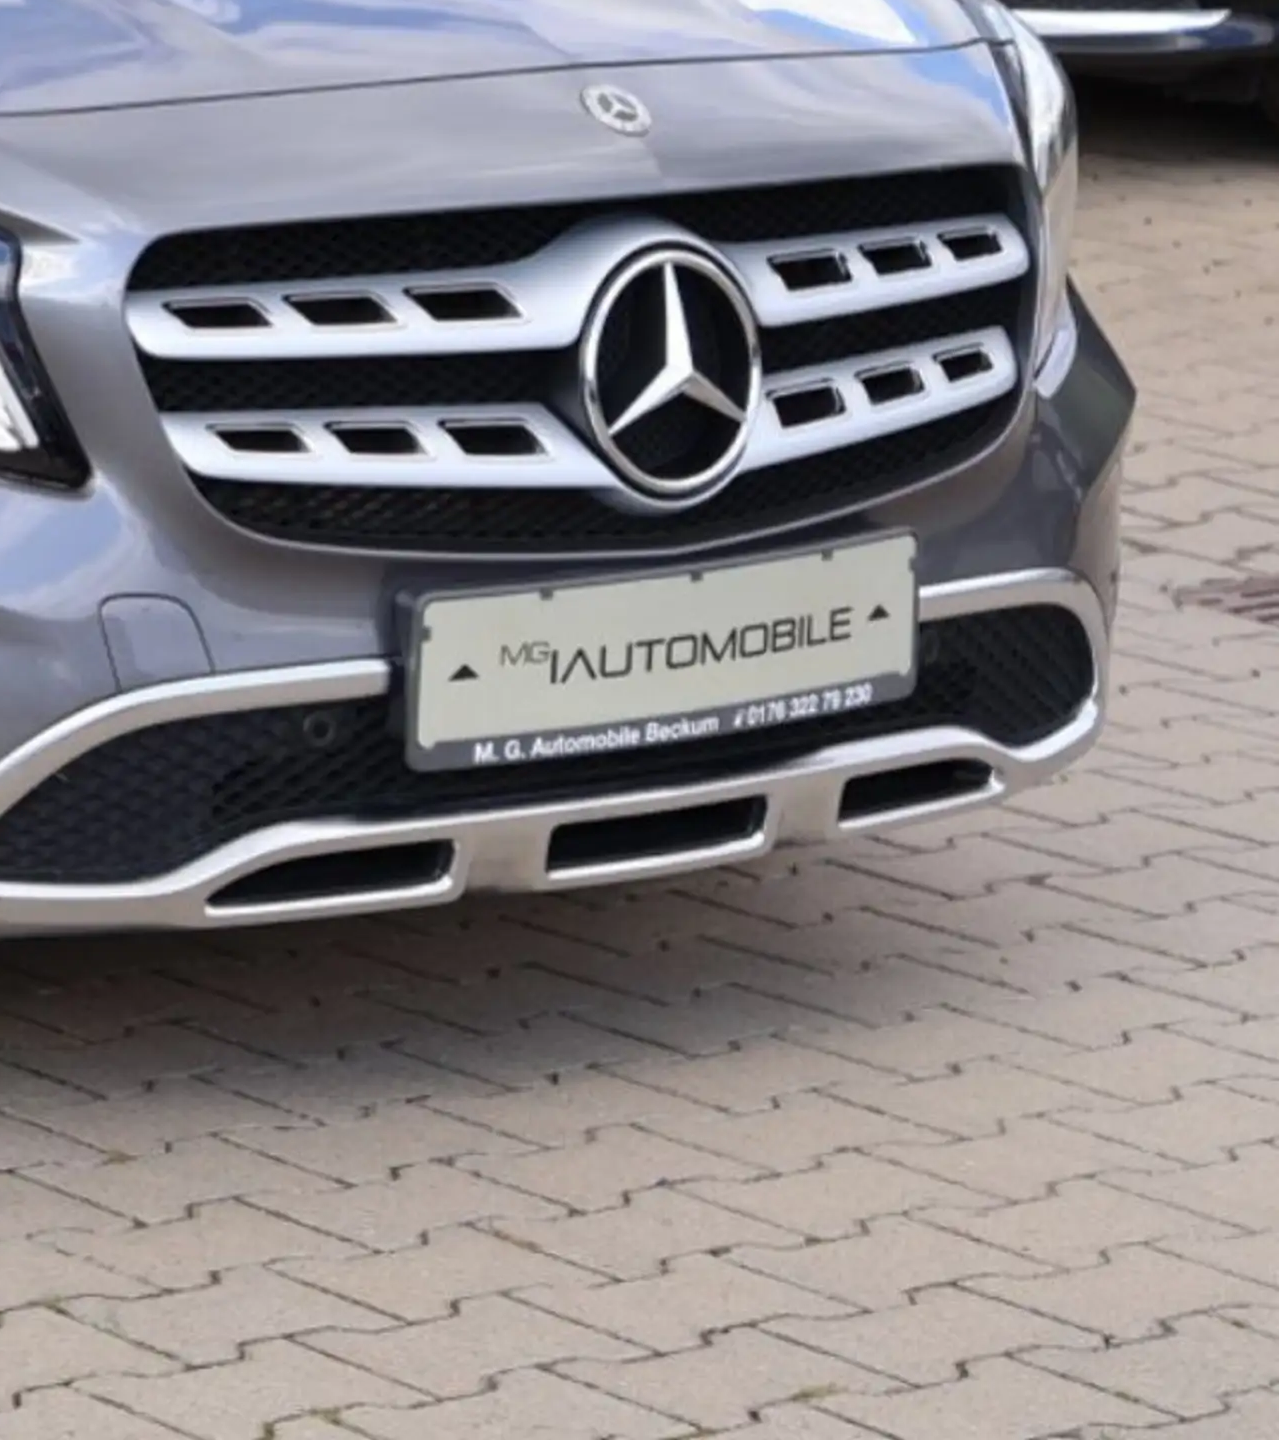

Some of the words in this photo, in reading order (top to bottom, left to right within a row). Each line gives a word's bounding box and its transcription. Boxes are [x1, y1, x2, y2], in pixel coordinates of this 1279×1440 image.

[504, 738, 525, 760] G.
[529, 725, 641, 758] Automobile
[645, 715, 720, 744] Beckum
